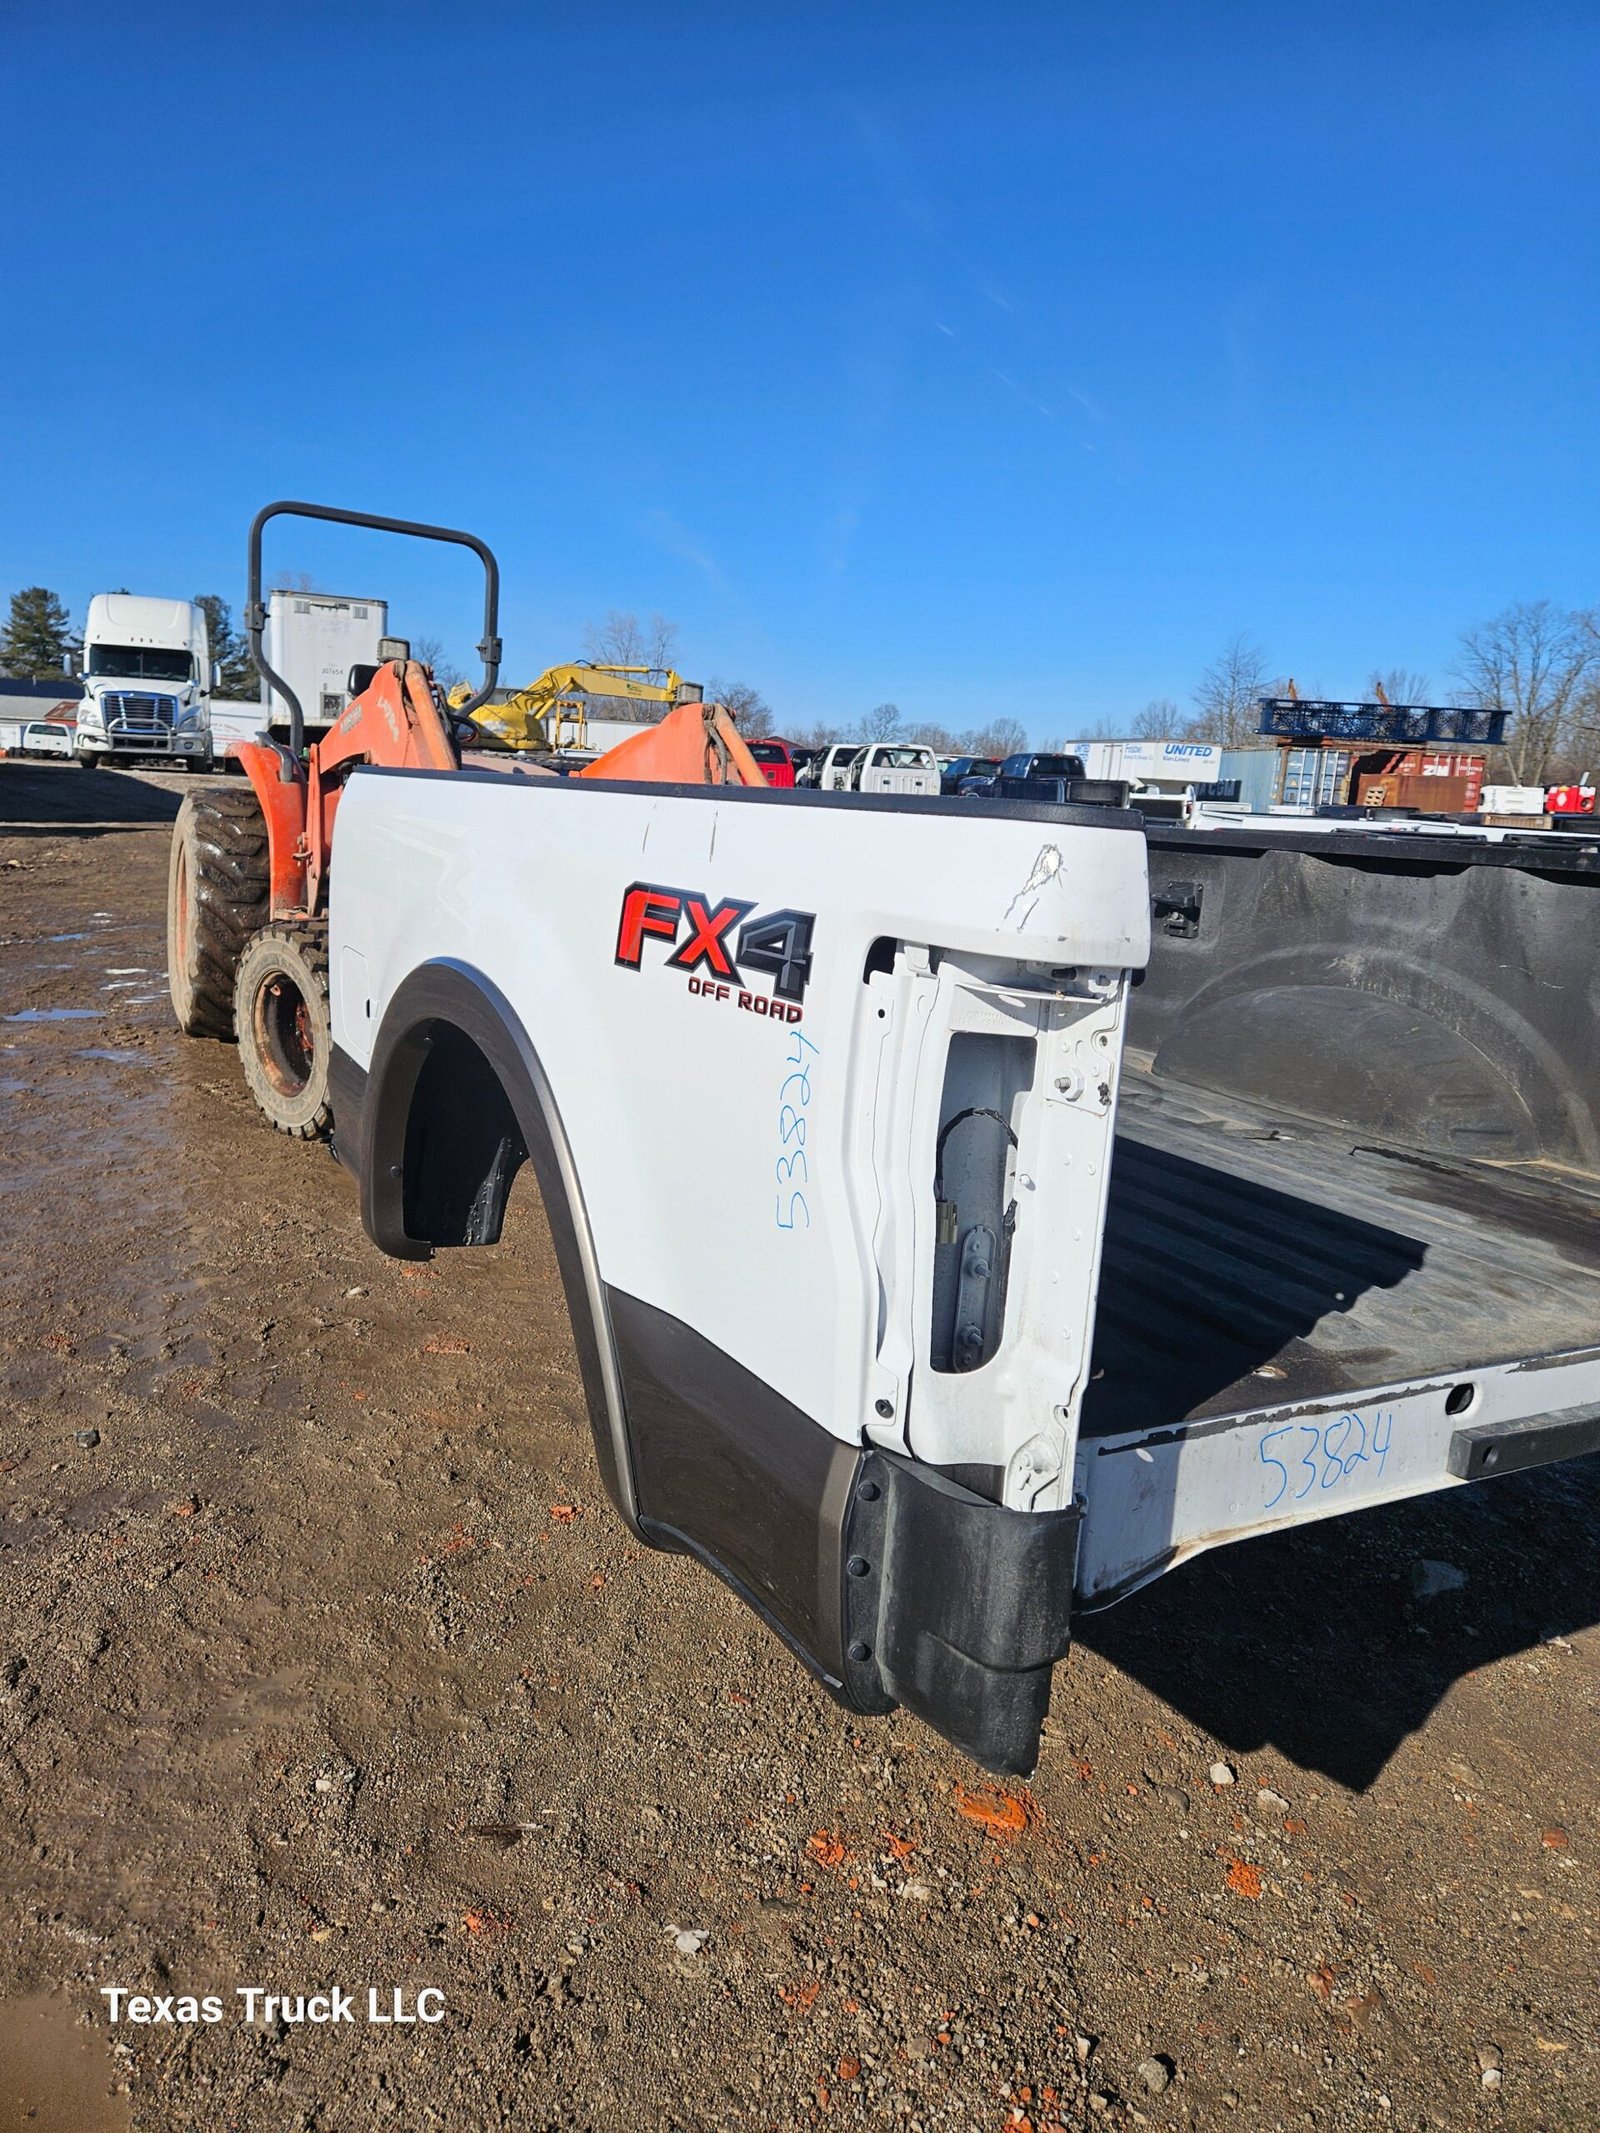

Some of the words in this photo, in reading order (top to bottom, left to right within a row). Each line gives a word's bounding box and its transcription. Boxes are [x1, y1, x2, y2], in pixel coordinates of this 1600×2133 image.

[1165, 744, 1212, 757] UNITED
[1423, 764, 1449, 776] ZIM
[614, 880, 817, 1004] FX4
[687, 976, 730, 1002] OFF
[738, 990, 803, 1024] ROAD
[776, 1028, 820, 1229] 53824
[1259, 1411, 1393, 1508] 53824
